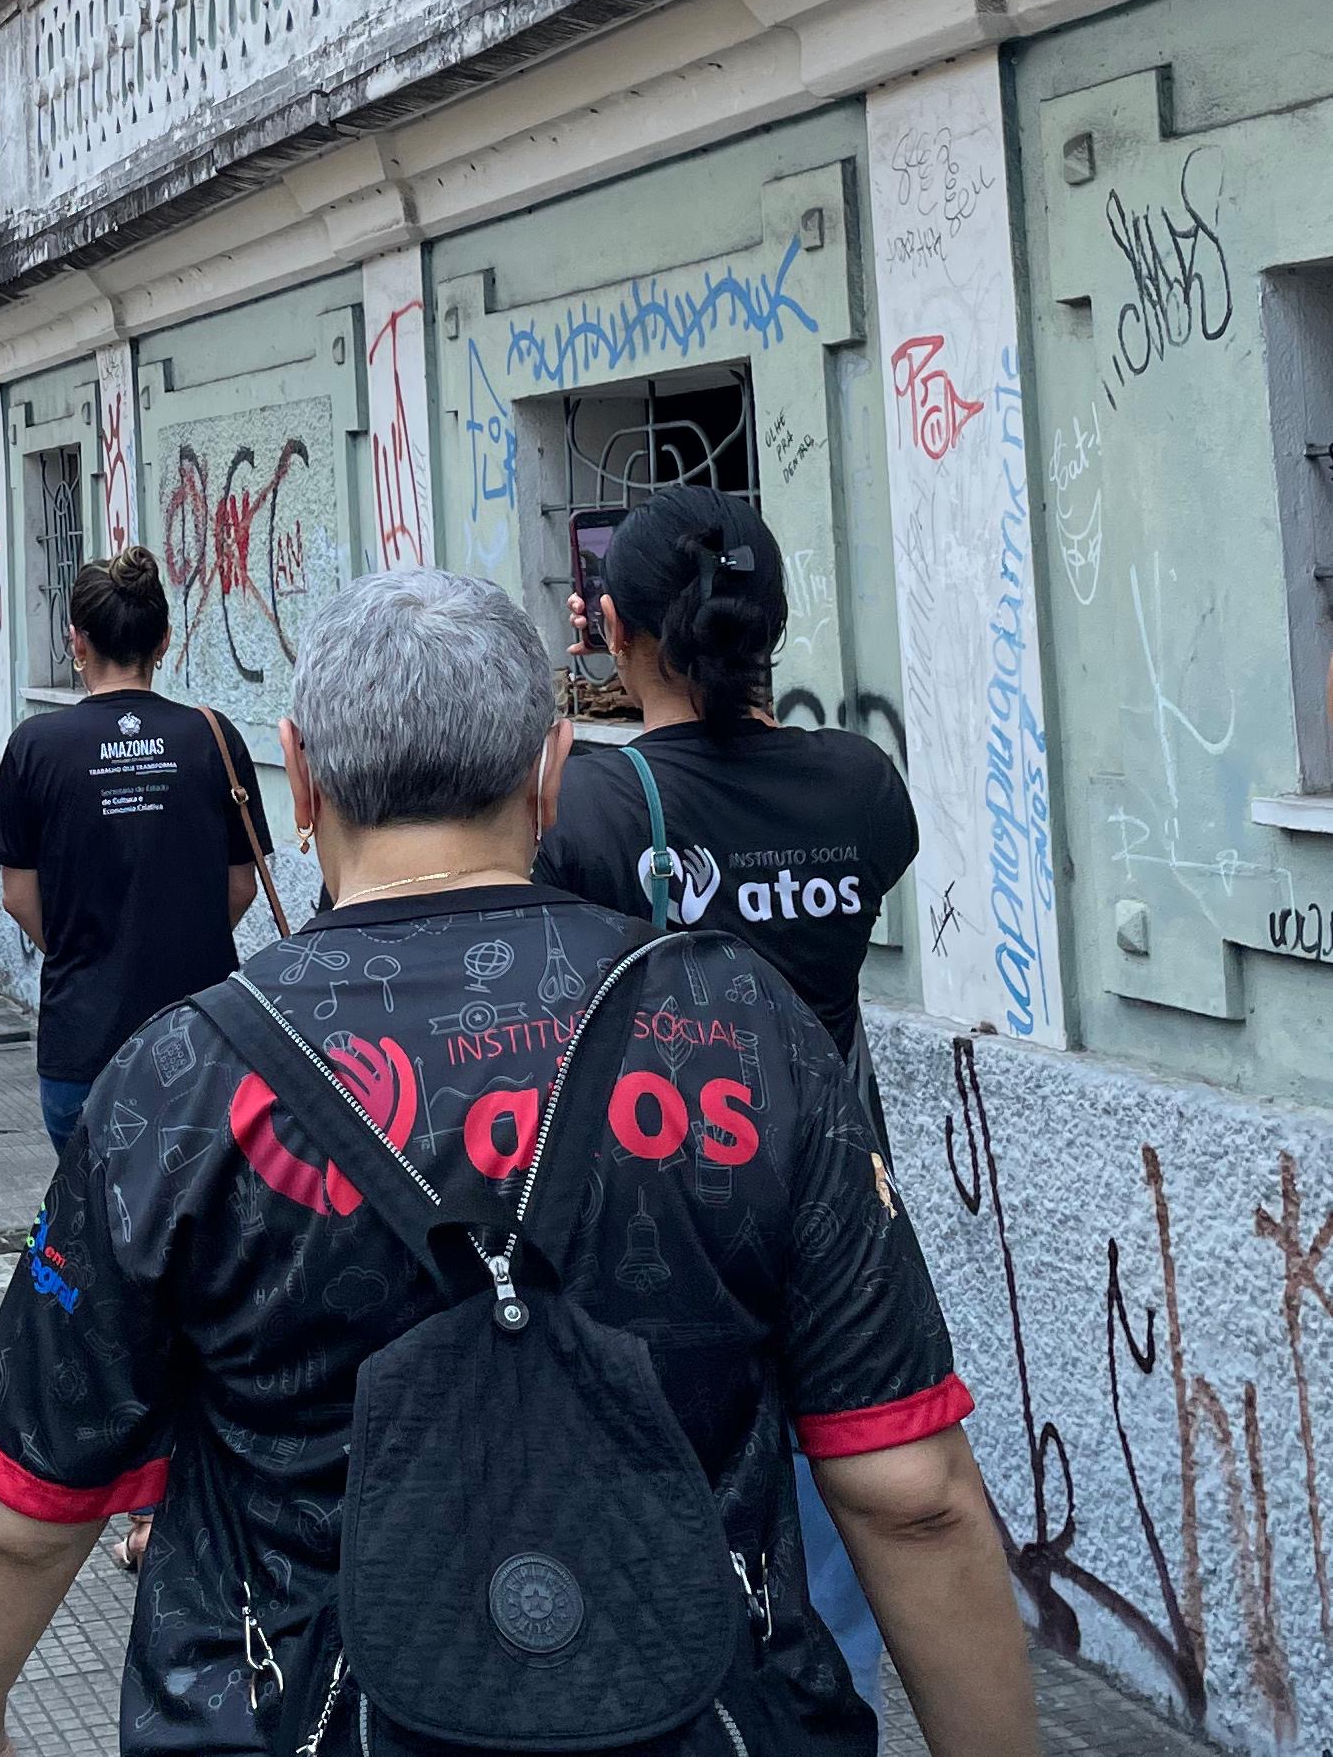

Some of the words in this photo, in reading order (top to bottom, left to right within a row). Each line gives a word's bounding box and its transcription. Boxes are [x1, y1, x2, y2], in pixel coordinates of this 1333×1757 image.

[100, 737, 165, 759] AMAZONAS
[88, 766, 122, 776] TRABALHO
[122, 764, 136, 773] QUE
[136, 761, 178, 771] TRANSFORMA
[101, 798, 112, 806] de
[112, 796, 137, 806] Cultura
[102, 807, 136, 816] Economia
[729, 849, 807, 869] INSTITUTO
[810, 845, 860, 864] SOCIAL
[738, 869, 862, 922] atos
[447, 1009, 588, 1066] INSTITU
[633, 1010, 746, 1050] SOCIAL
[464, 1055, 760, 1180] aos
